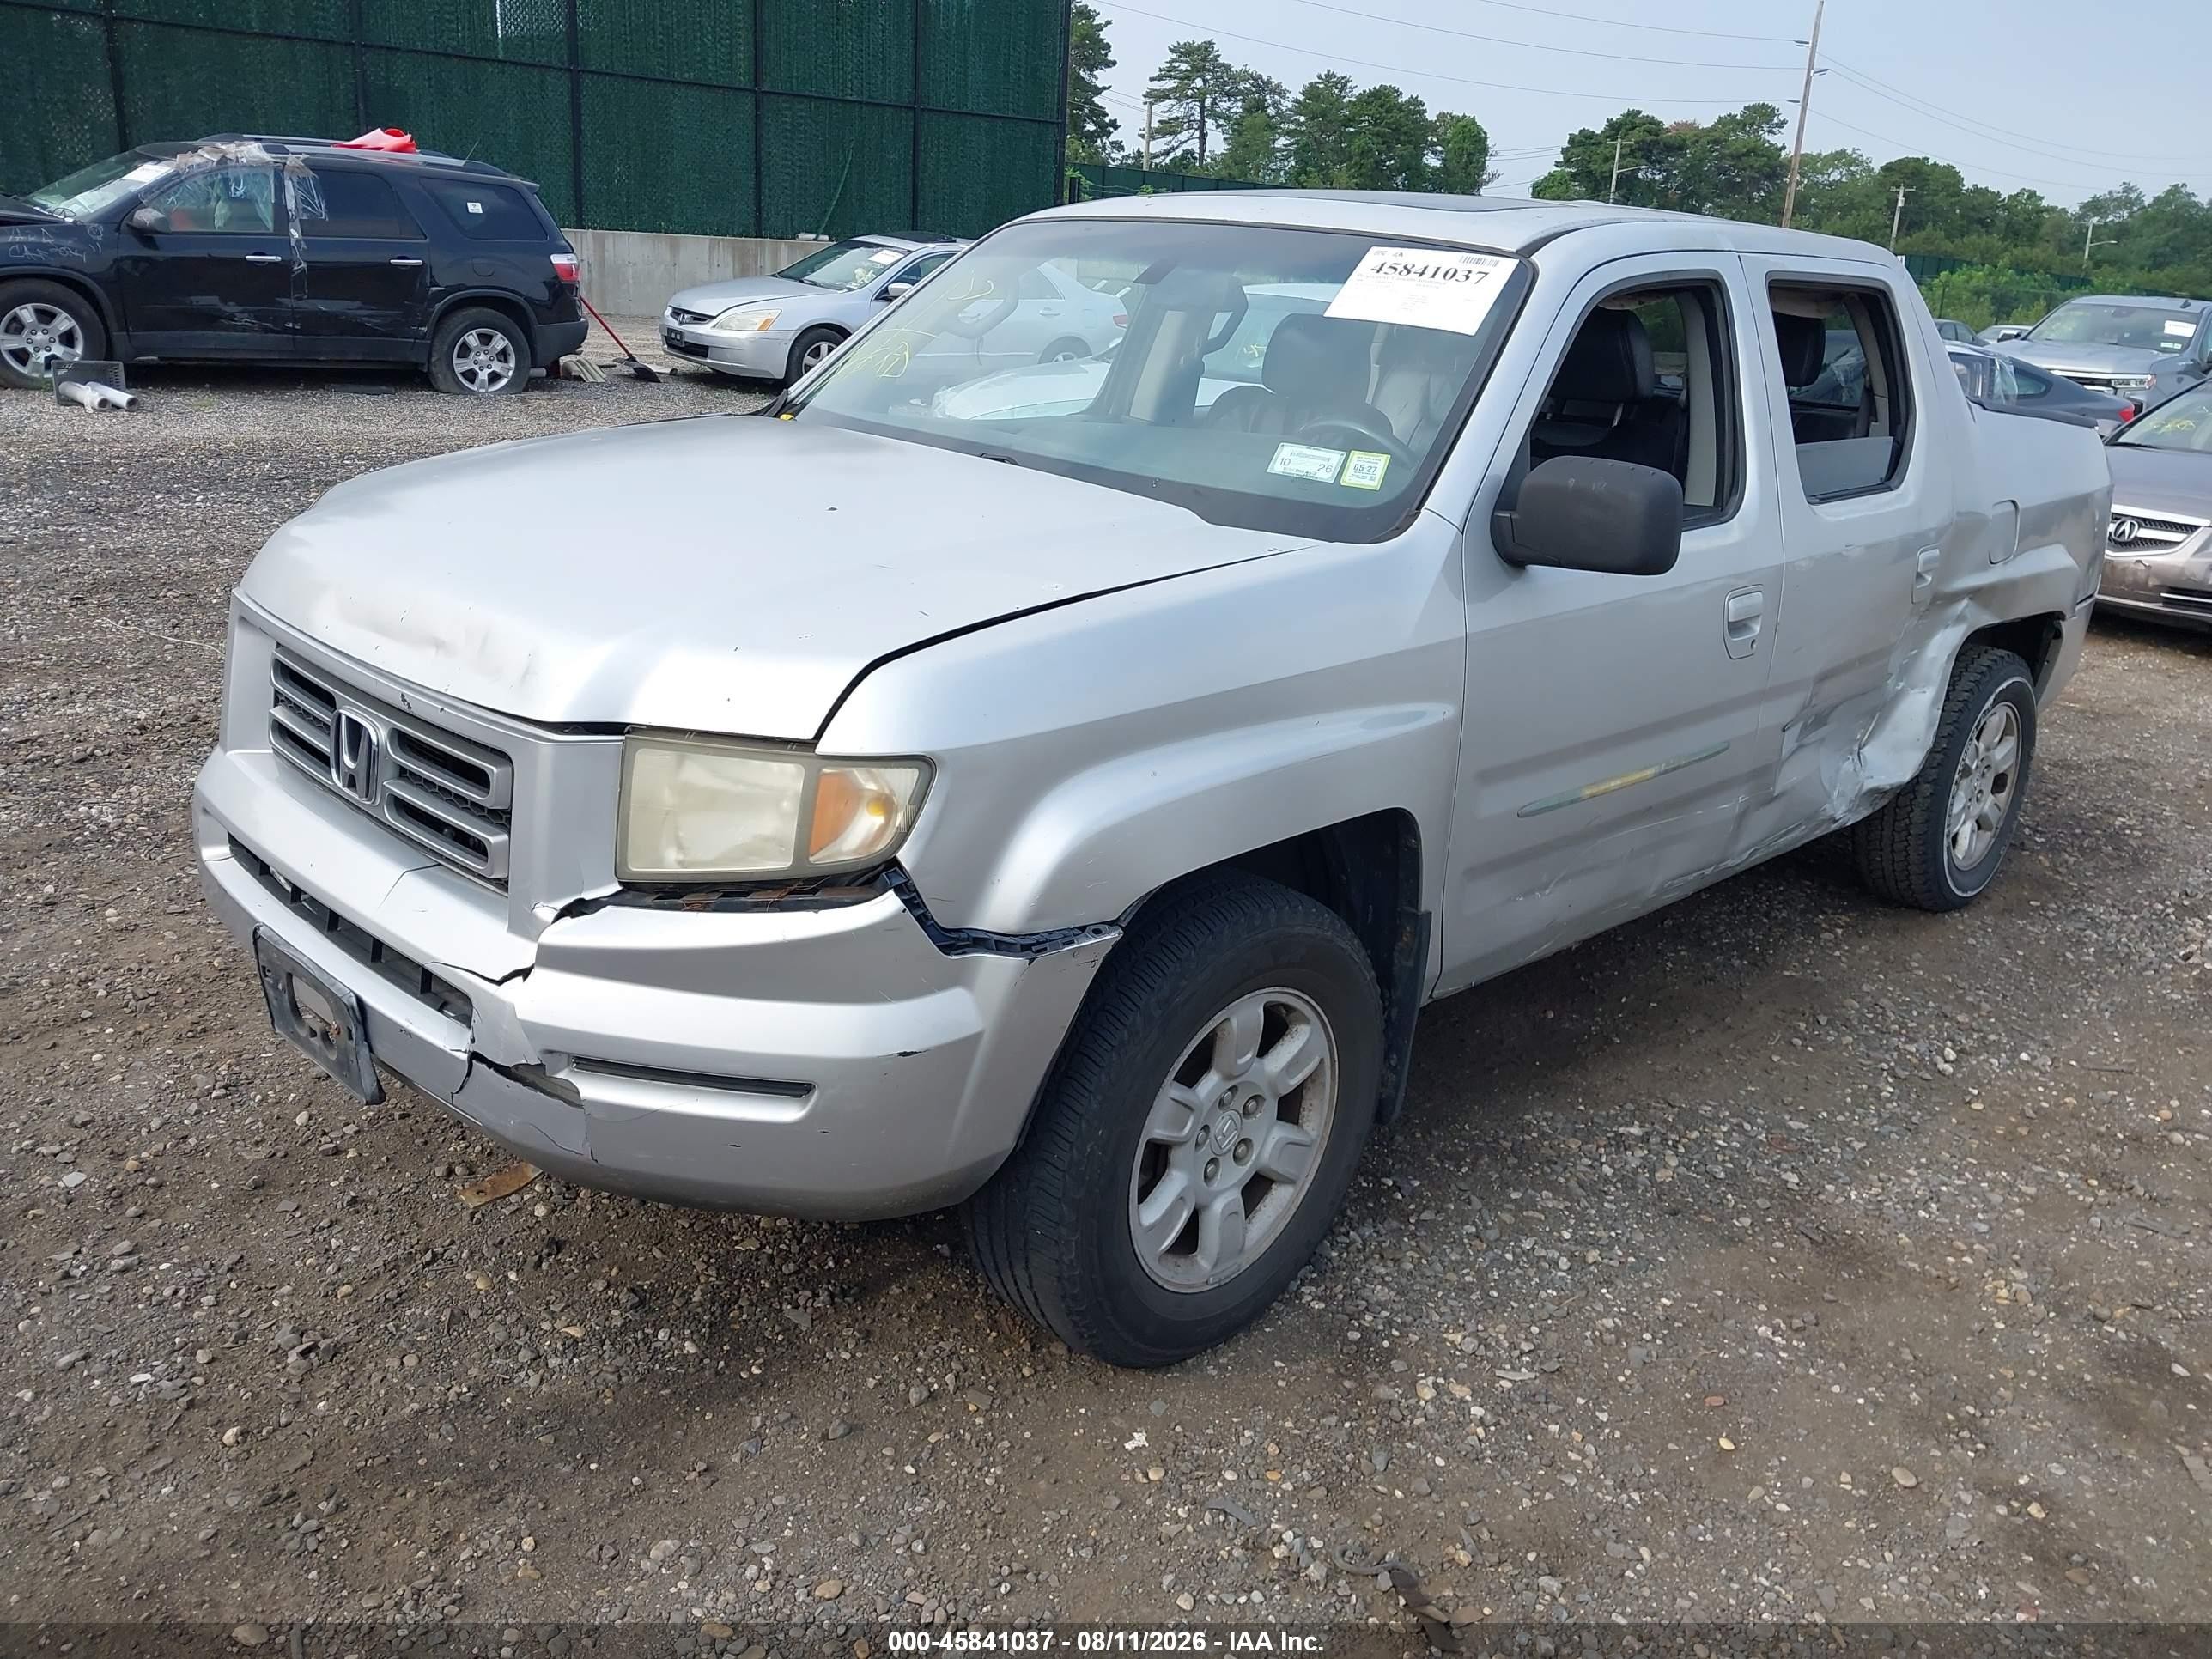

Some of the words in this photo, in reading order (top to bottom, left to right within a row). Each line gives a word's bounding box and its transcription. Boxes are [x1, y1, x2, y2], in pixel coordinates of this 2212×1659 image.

[1370, 261, 1489, 284] 45841037
[1279, 458, 1290, 466] 10
[1317, 464, 1333, 473] 26
